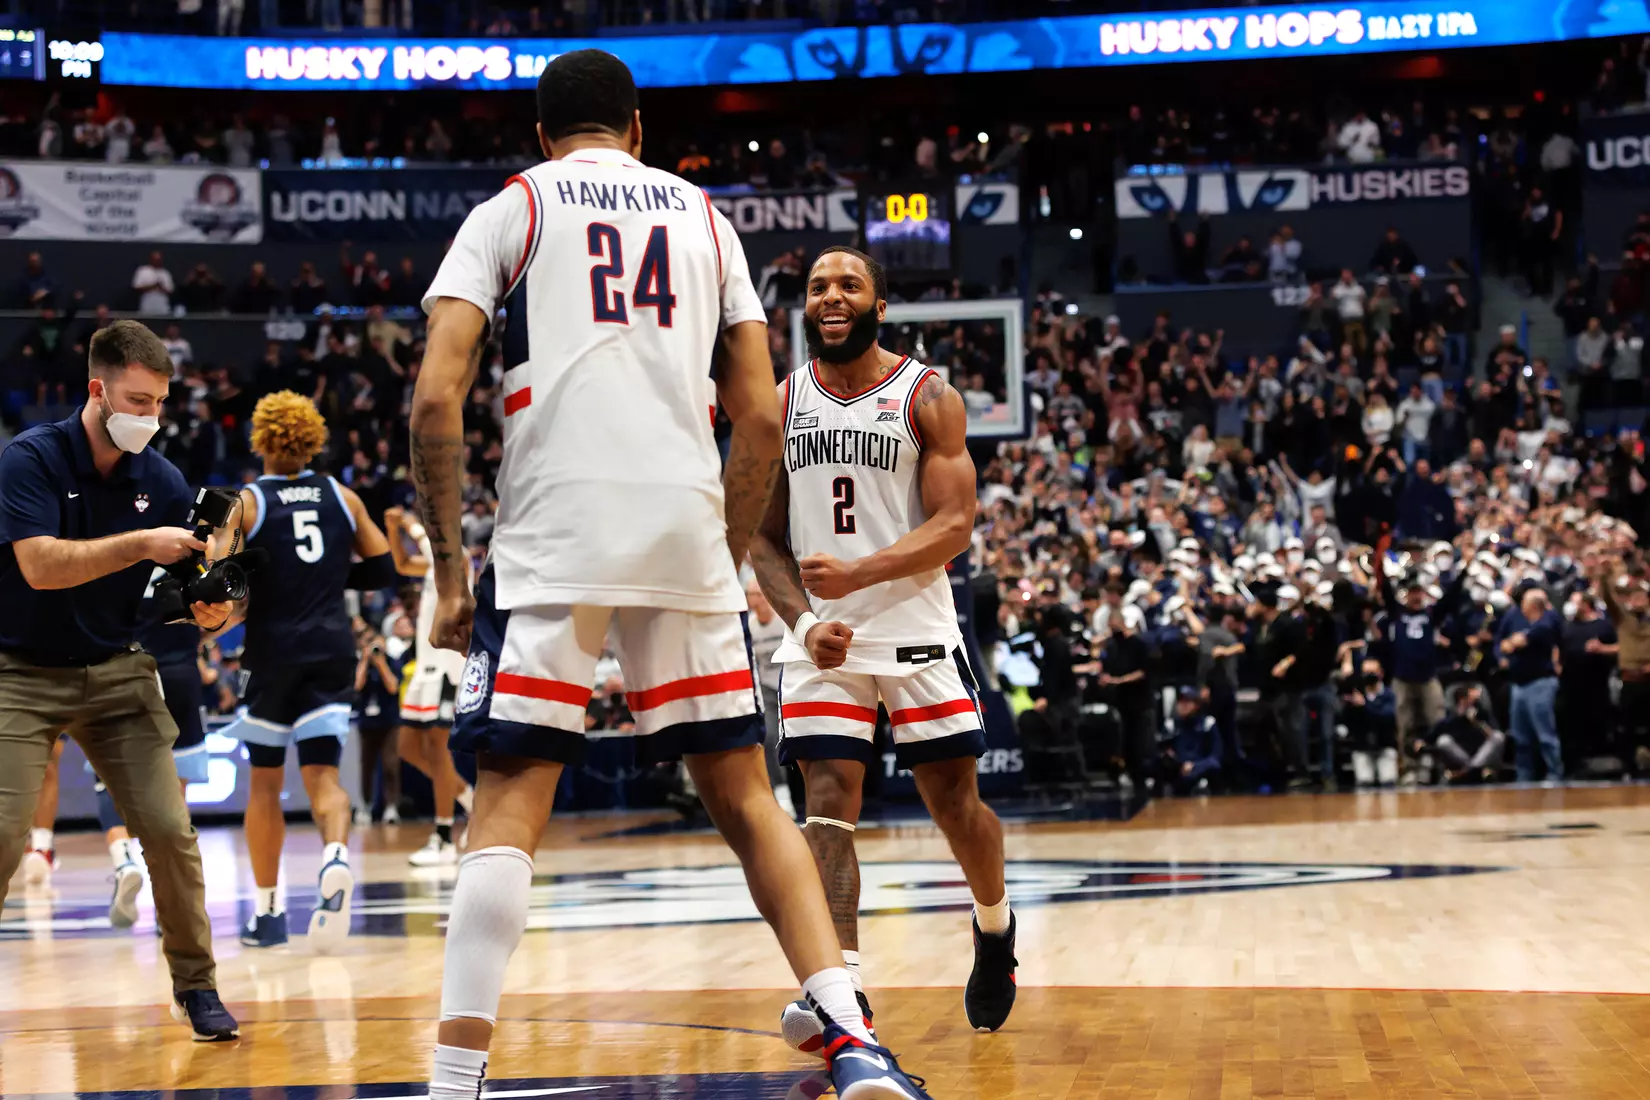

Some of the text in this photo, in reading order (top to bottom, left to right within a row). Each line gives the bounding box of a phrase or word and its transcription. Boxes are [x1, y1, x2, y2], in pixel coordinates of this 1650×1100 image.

[1100, 9, 1478, 55] HUSKY HOPS HAZY IPA
[61, 60, 92, 78] PM
[246, 46, 388, 80] HUSKY
[393, 46, 512, 80] HOPS
[64, 168, 155, 185] Basketball
[1309, 166, 1470, 203] HUSKIES
[78, 187, 141, 203] Capital
[84, 205, 136, 219] of the
[271, 190, 406, 222] UCONN
[556, 180, 687, 212] HAWKINS
[587, 221, 677, 328] 24
[787, 429, 901, 472] CONNECTICUT
[832, 476, 856, 534] 2
[292, 510, 325, 564] 5
